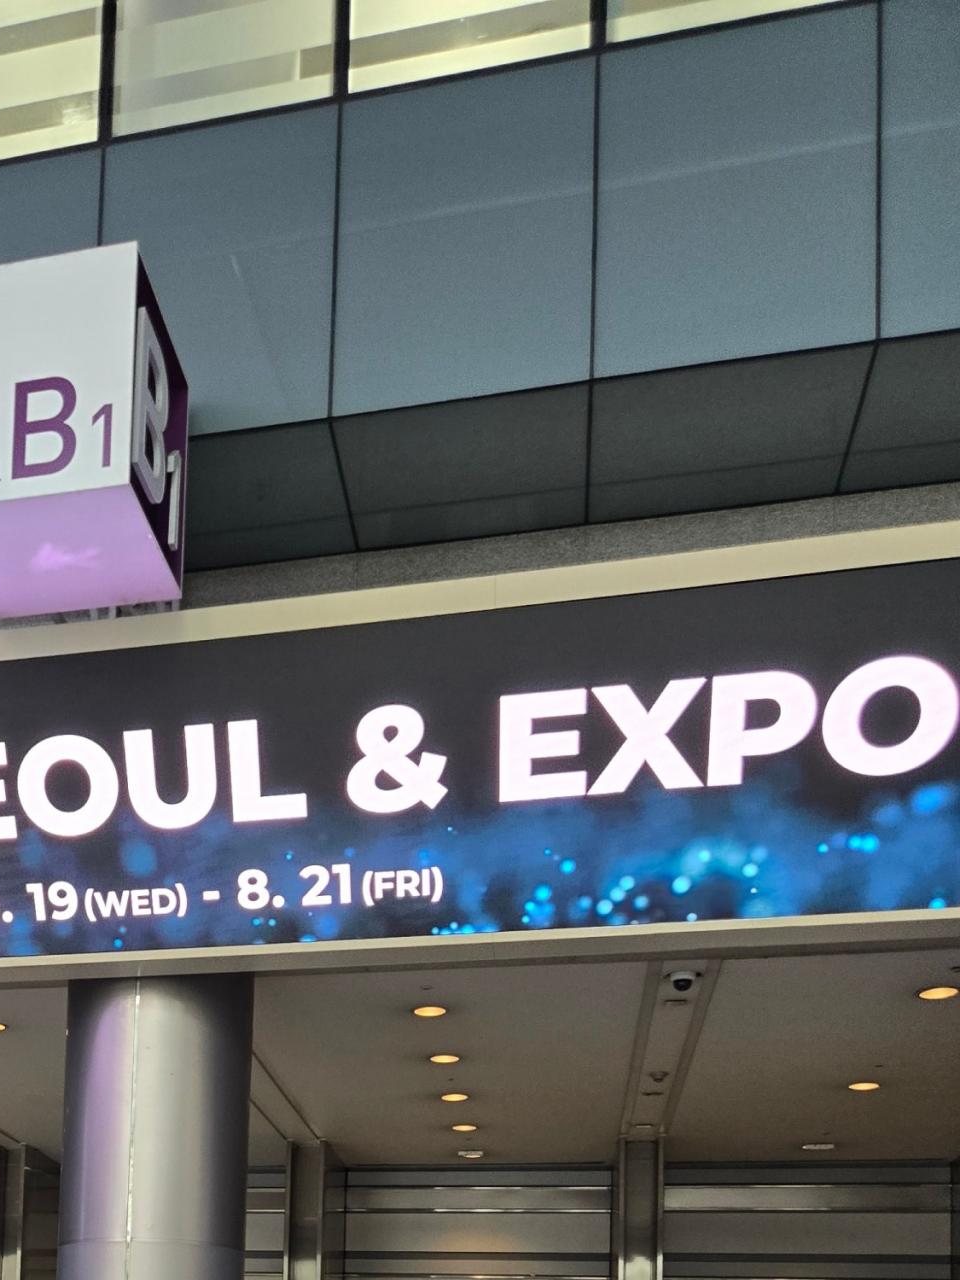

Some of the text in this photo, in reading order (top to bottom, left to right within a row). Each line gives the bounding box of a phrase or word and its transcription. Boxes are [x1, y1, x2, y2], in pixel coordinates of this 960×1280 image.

[11, 376, 113, 480] B1
[346, 704, 448, 813] &
[499, 656, 959, 803] EXPO
[237, 869, 285, 910] 8.
